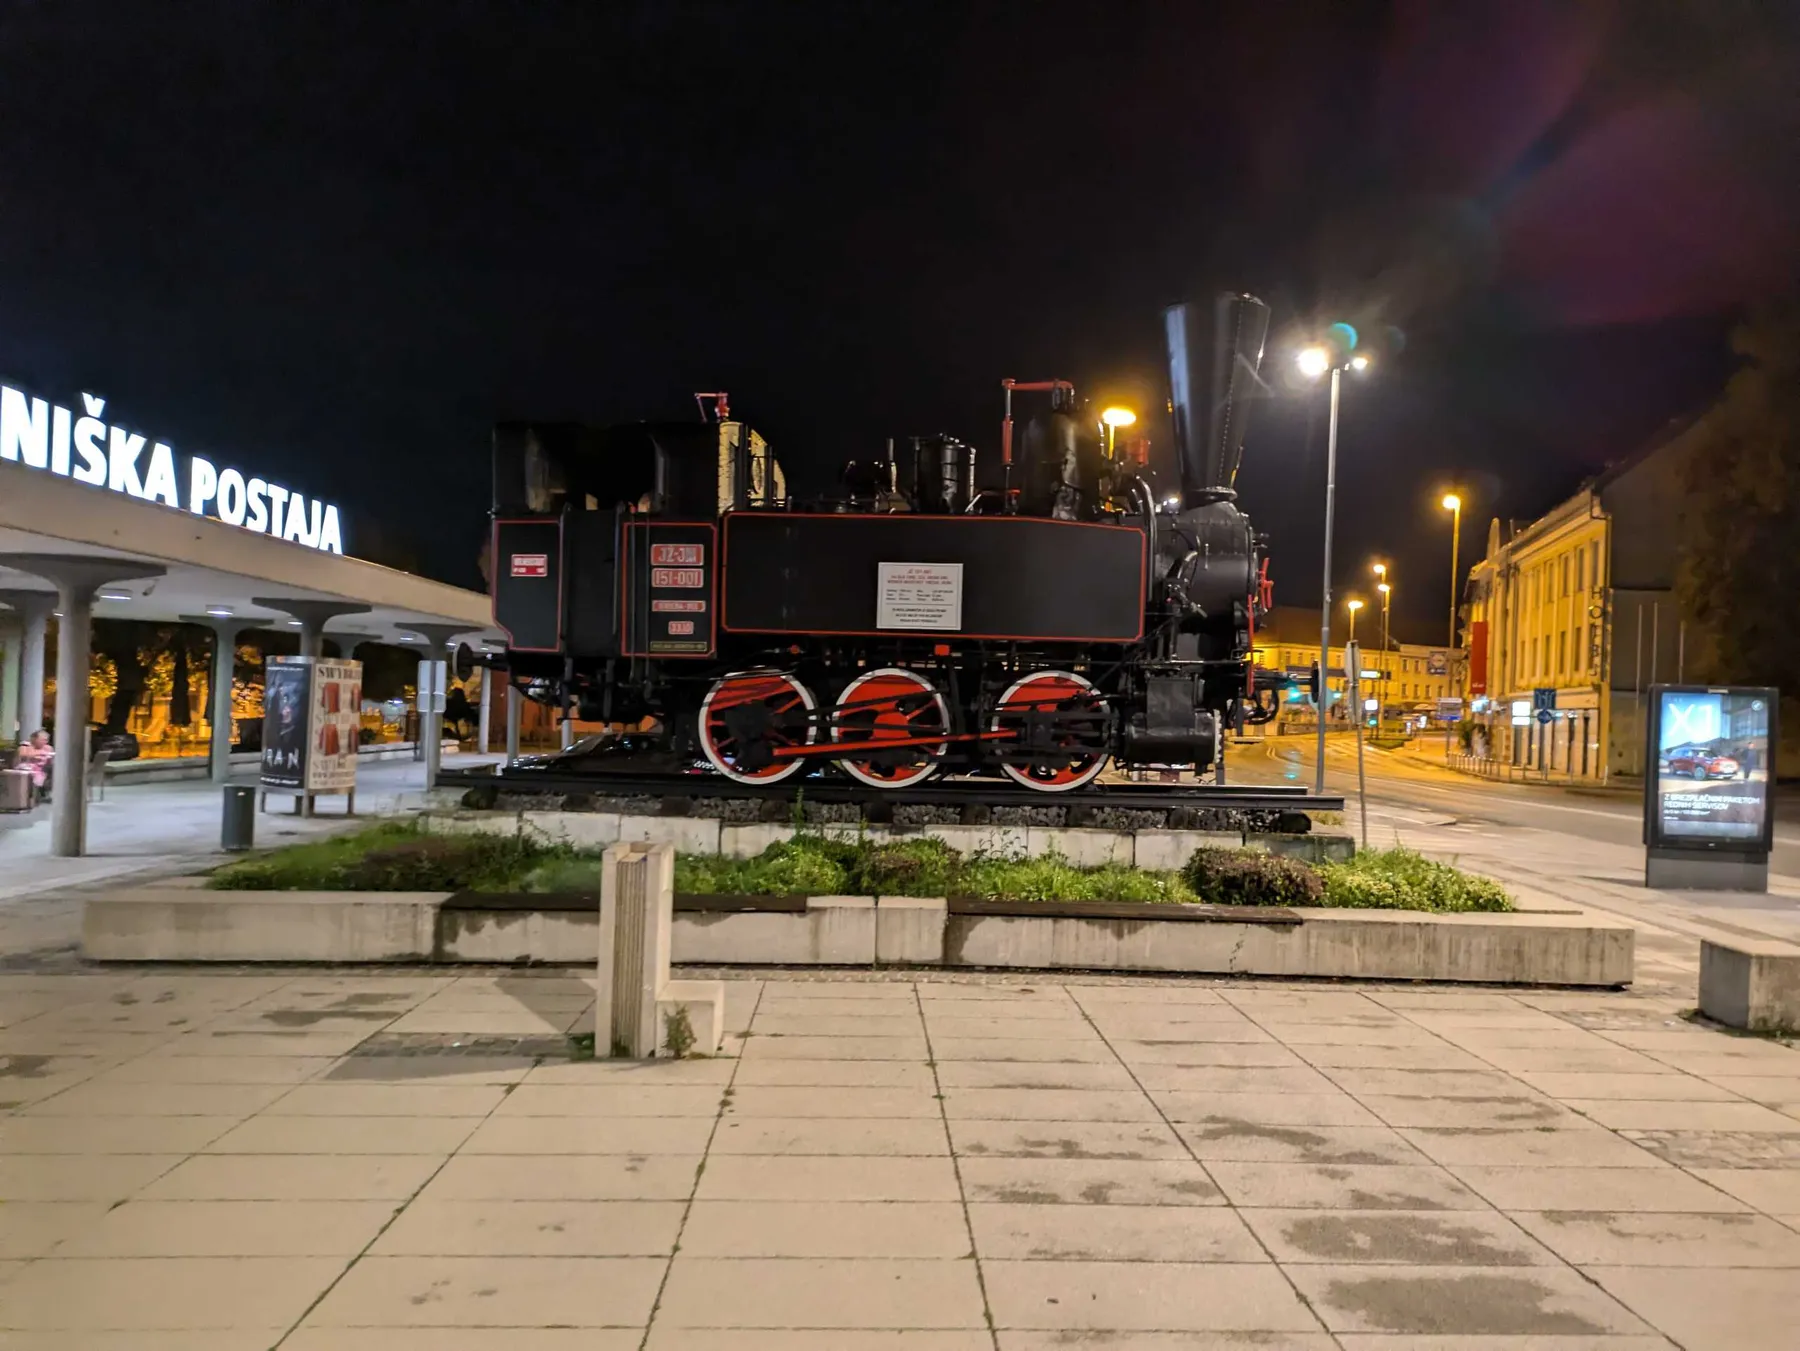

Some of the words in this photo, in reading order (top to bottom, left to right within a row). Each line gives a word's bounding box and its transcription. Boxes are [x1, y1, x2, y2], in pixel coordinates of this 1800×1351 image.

[1, 385, 178, 508] NIŠKA
[190, 457, 342, 554] POSTAJA
[655, 571, 699, 585] 151-001
[1668, 703, 1712, 737] X1
